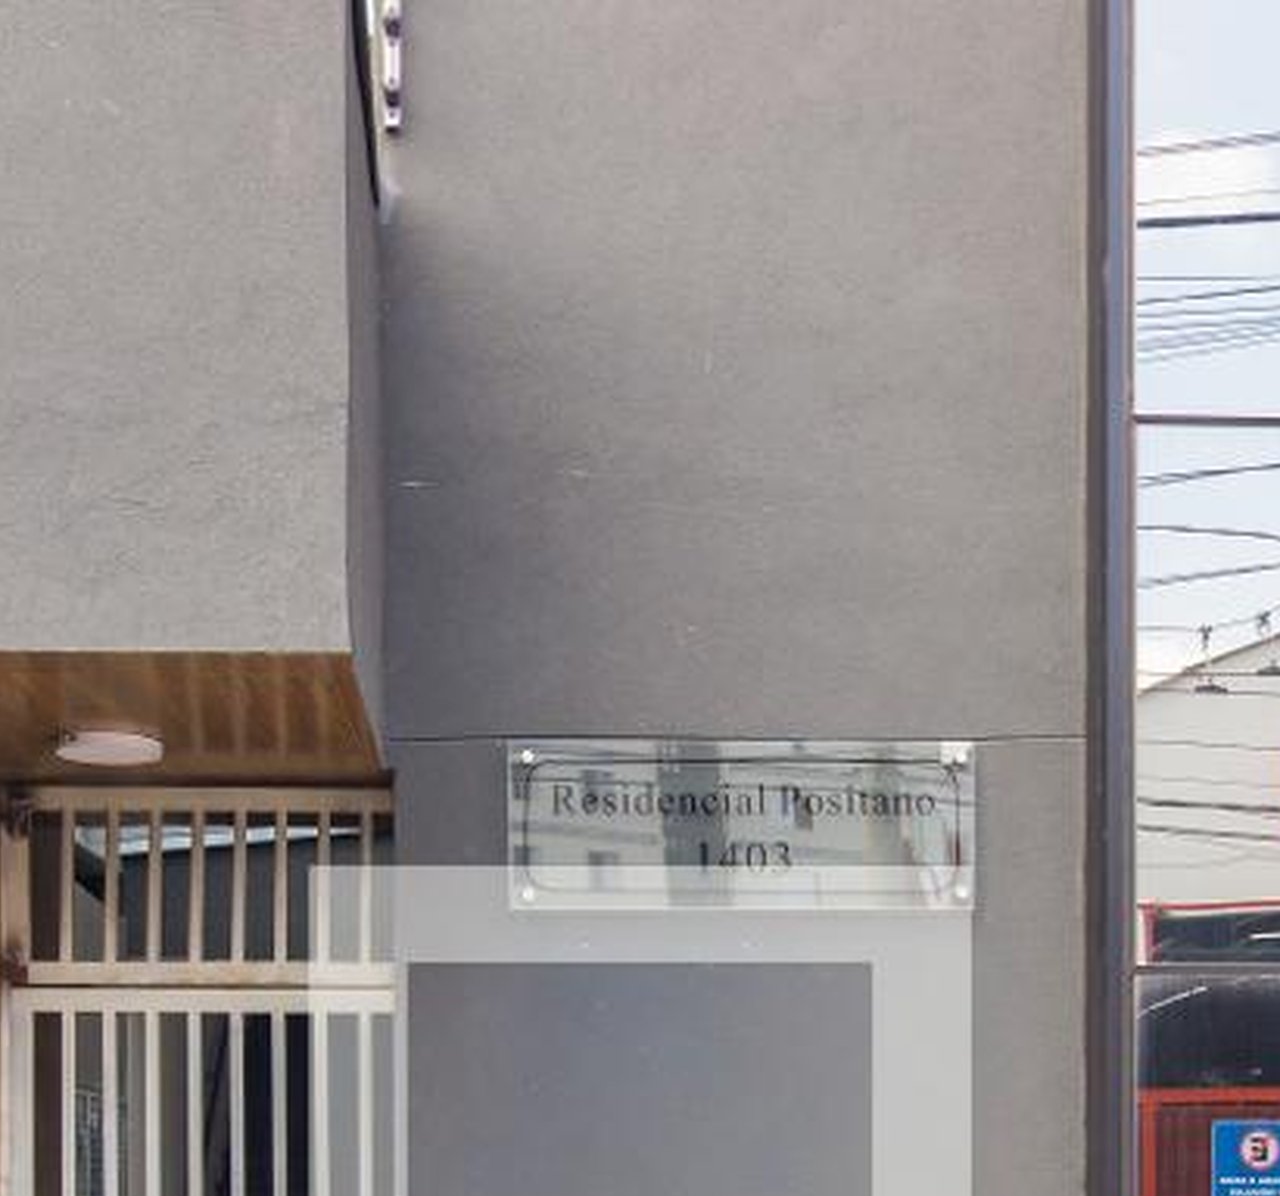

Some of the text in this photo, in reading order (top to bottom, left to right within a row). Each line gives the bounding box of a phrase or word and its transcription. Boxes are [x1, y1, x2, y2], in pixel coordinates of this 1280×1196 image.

[552, 783, 936, 818] Residencial Positano
[697, 841, 794, 873] 1403
